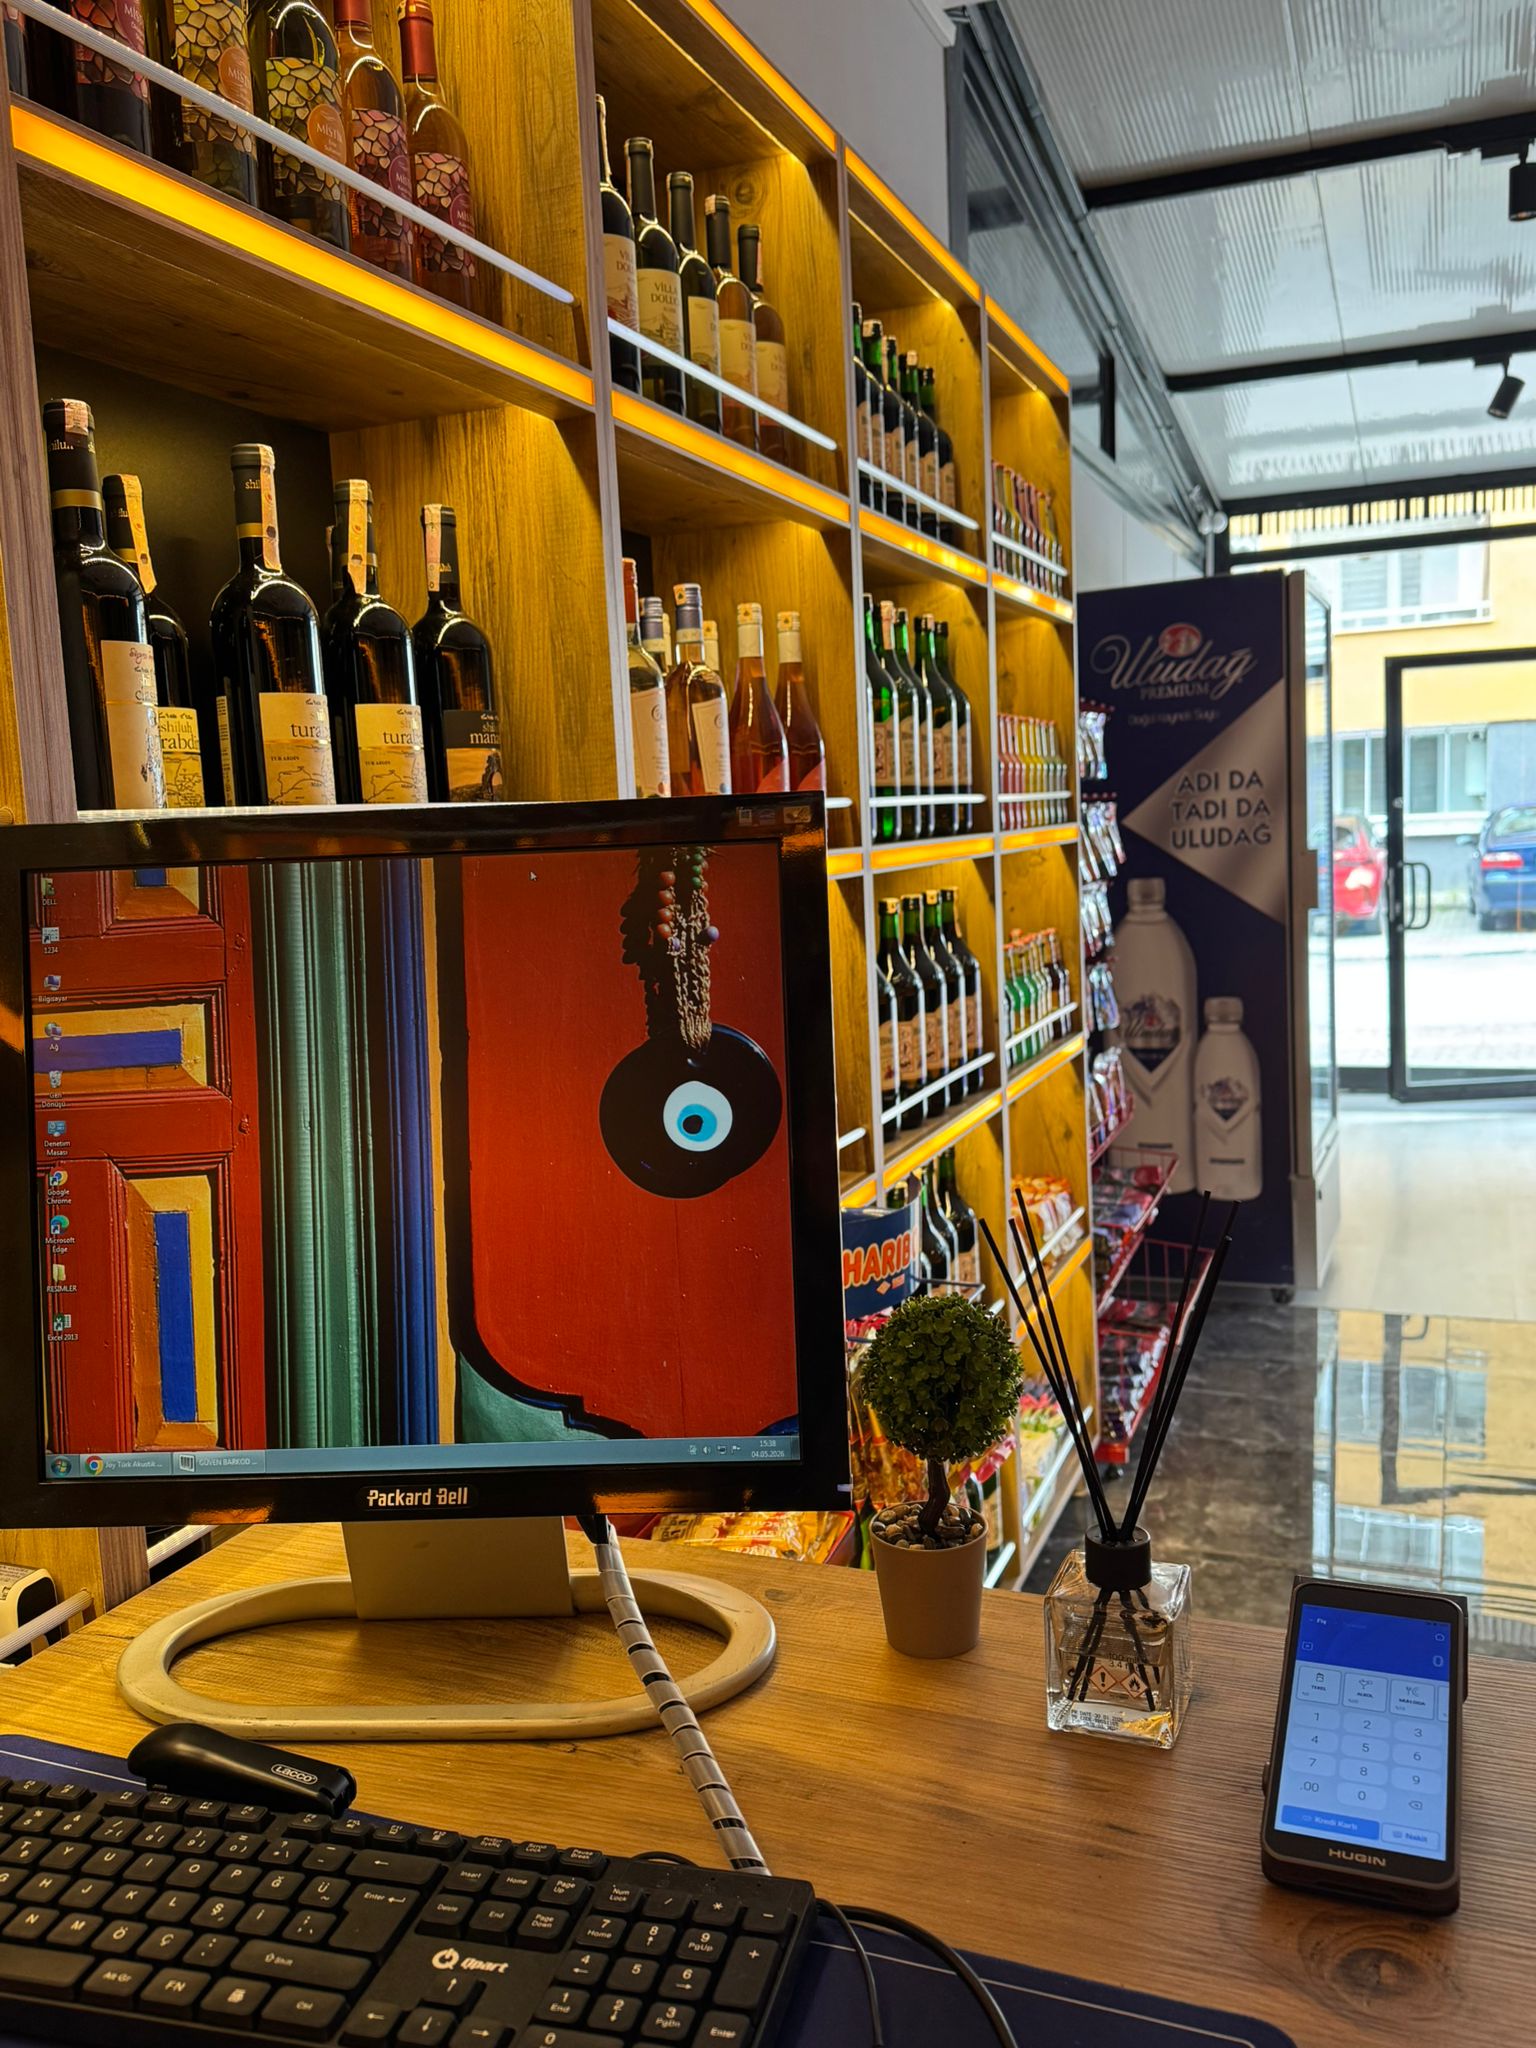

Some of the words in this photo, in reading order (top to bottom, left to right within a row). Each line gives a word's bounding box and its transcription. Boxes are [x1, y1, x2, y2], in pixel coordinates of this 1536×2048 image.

[1090, 634, 1258, 700] Uludağ
[1141, 683, 1211, 700] PREMIUM
[1177, 772, 1219, 794] ADI
[1229, 770, 1264, 791] DA
[1172, 801, 1227, 821] TADI
[1236, 799, 1271, 818] DA
[1171, 823, 1272, 850] ULUDAĞ
[44, 946, 58, 954] 1234
[44, 1140, 71, 1148] Denetim
[47, 1188, 70, 1197] Google
[46, 1197, 72, 1205] Chrome
[45, 1237, 76, 1245] Microsoft
[52, 1246, 68, 1254] Edge
[47, 1333, 63, 1342] Excel
[64, 1333, 79, 1341] 2013
[759, 1439, 777, 1448] 15:38
[366, 1488, 432, 1507] Packard
[436, 1486, 468, 1505] Bell
[1313, 1711, 1321, 1722] 1
[1362, 1719, 1371, 1730] 2
[1413, 1728, 1423, 1739] 3
[1311, 1735, 1319, 1745] 4
[1362, 1743, 1370, 1754] 5
[1413, 1752, 1422, 1762] 6
[1309, 1758, 1318, 1768] 7
[1360, 1767, 1368, 1778] 8
[1411, 1775, 1421, 1786] 9
[1357, 1790, 1367, 1802] 0
[21, 1841, 32, 1850] T
[63, 1846, 75, 1856] Y
[103, 1852, 118, 1862] U
[1328, 1847, 1387, 1867] HUGIN
[188, 1863, 201, 1874] O
[230, 1868, 243, 1879] P
[459, 1869, 482, 1880] Insert
[38, 1878, 53, 1889] H
[506, 1876, 529, 1885] Home
[556, 1880, 577, 1890] Page
[81, 1884, 93, 1895] J
[317, 1881, 331, 1894] Ü
[553, 1886, 565, 1895] Up
[612, 1887, 631, 1897] Num
[125, 1889, 140, 1901] K
[363, 1891, 386, 1902] Enter
[609, 1894, 628, 1902] Lock
[168, 1896, 178, 1907] L
[25, 1913, 40, 1925] N
[488, 1910, 505, 1920] End
[535, 1913, 555, 1923] Page
[70, 1919, 87, 1932] M
[531, 1919, 554, 1929] Down
[600, 1918, 612, 1930] 7
[112, 1926, 130, 1941] Ö
[586, 1928, 613, 1940] Home
[648, 1924, 660, 1937] 8
[159, 1933, 175, 1948] Ç
[699, 1932, 712, 1944] 9
[687, 1941, 715, 1954] PgUp
[580, 1954, 592, 1966] 4
[631, 1963, 643, 1976] 5
[681, 1968, 694, 1981] 6
[103, 1970, 117, 1982] Alt
[117, 1972, 133, 1984] Gr
[164, 1980, 187, 1993] FN
[550, 2003, 572, 2014] End
[665, 2006, 678, 2019] 3
[655, 2017, 682, 2030] PgDn
[709, 2026, 737, 2040] Enter
[544, 2032, 557, 2046] 0
